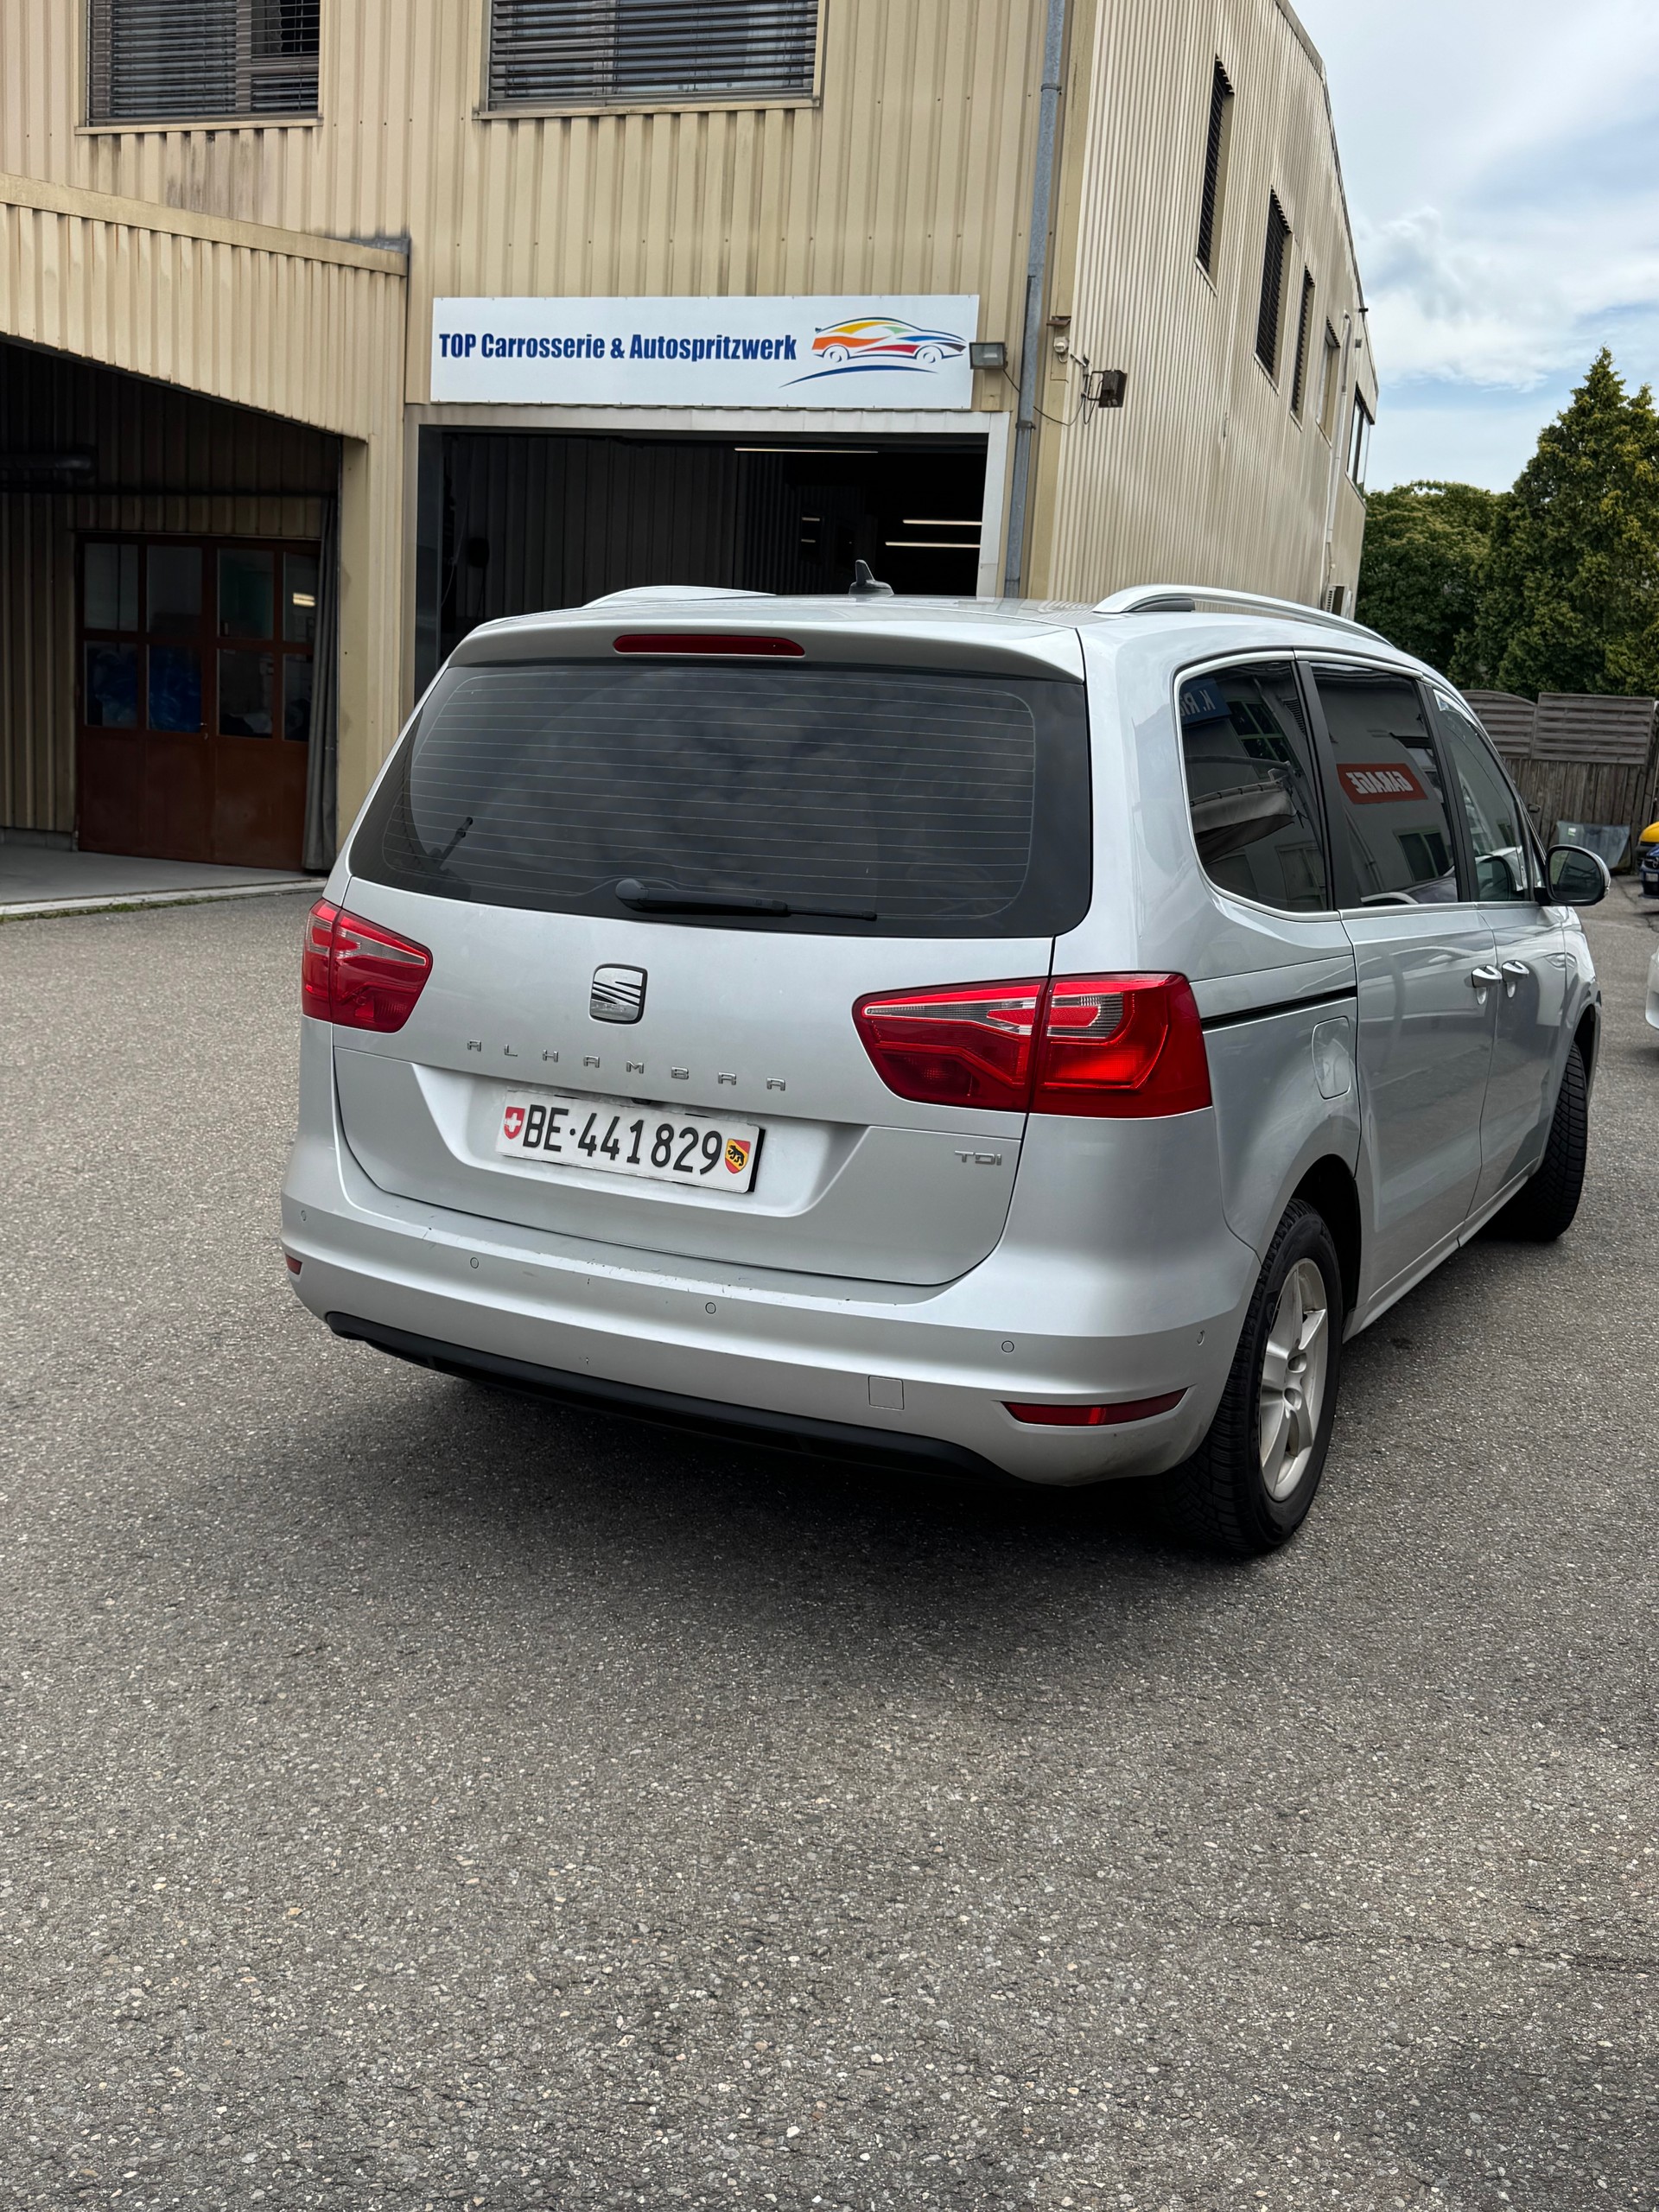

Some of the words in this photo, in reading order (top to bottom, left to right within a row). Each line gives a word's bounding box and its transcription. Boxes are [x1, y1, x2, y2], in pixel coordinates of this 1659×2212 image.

[439, 333, 477, 359] TOP
[480, 333, 606, 359] Carrosserie
[609, 337, 626, 359] &
[629, 334, 798, 362] Autospritzwerk
[467, 1039, 787, 1092] ALHAMBRA
[954, 1150, 1002, 1166] TDI
